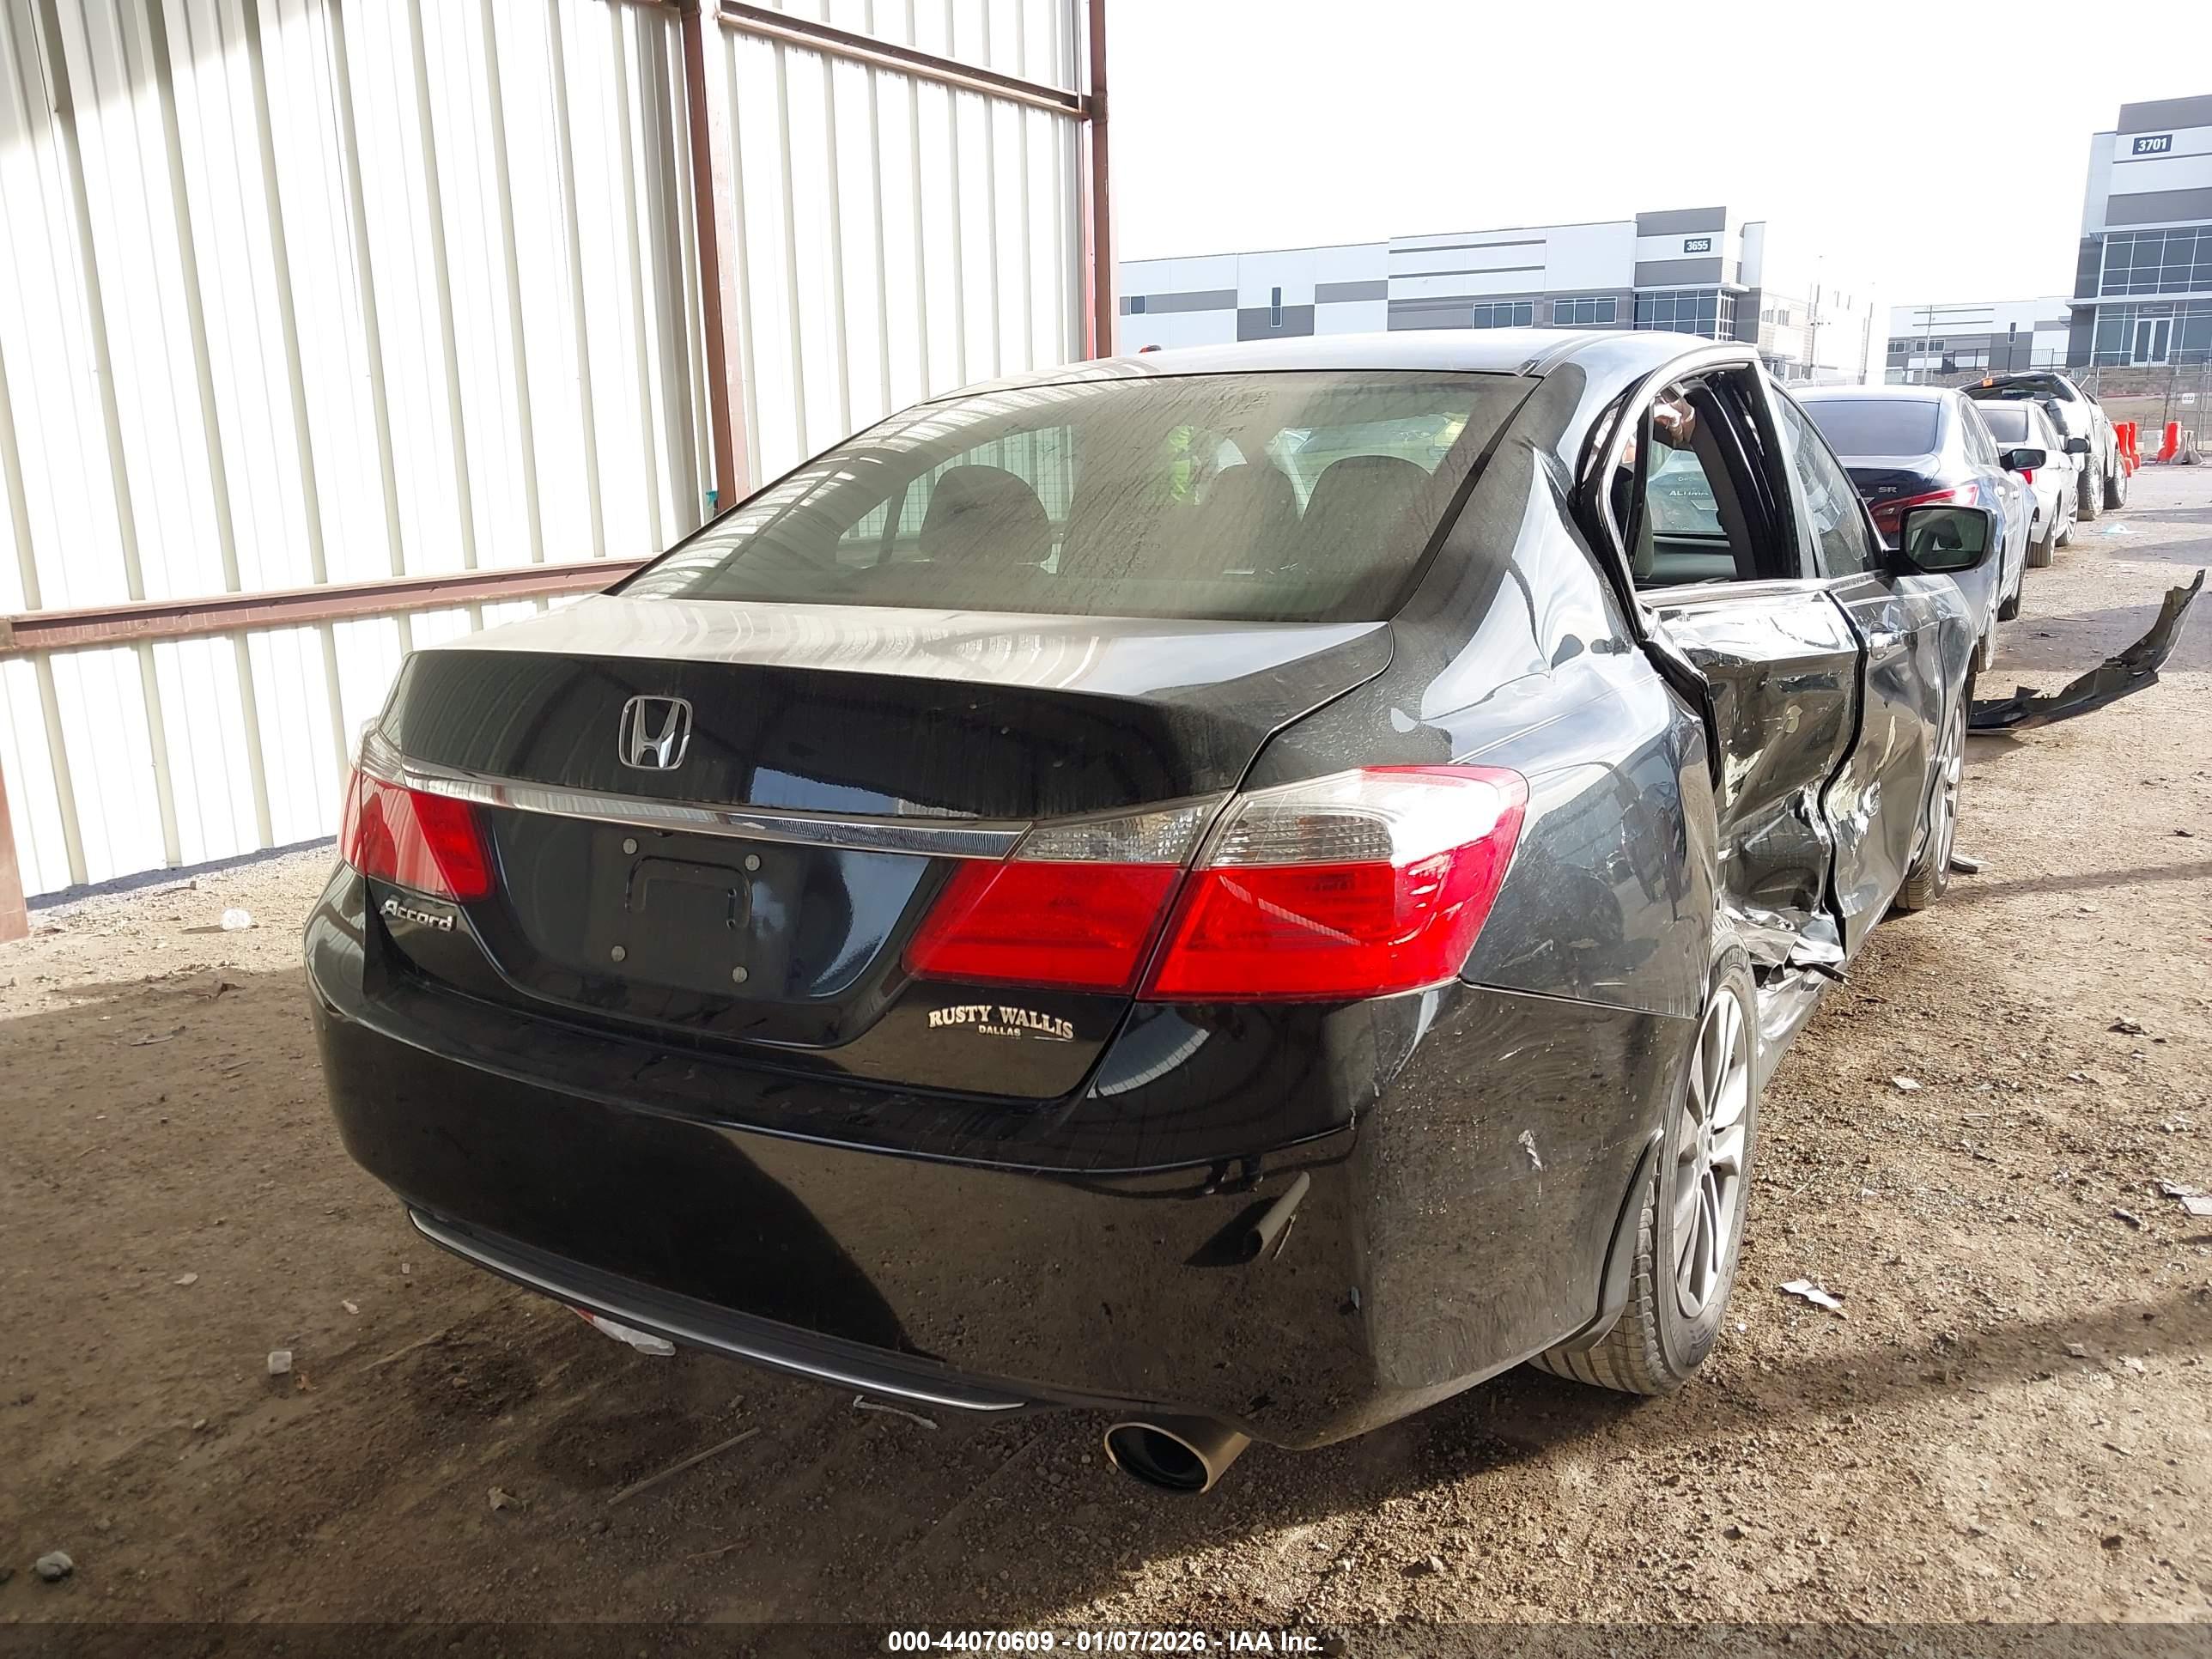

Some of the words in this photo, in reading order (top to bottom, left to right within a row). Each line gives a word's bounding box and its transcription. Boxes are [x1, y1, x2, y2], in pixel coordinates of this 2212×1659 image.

[2137, 137, 2167, 152] 3701
[1686, 240, 1709, 251] 3655
[379, 898, 454, 932] Accord
[928, 1005, 993, 1028] RUSTY
[999, 1006, 1074, 1040] WALLIS
[978, 1024, 1021, 1036] DALLAS
